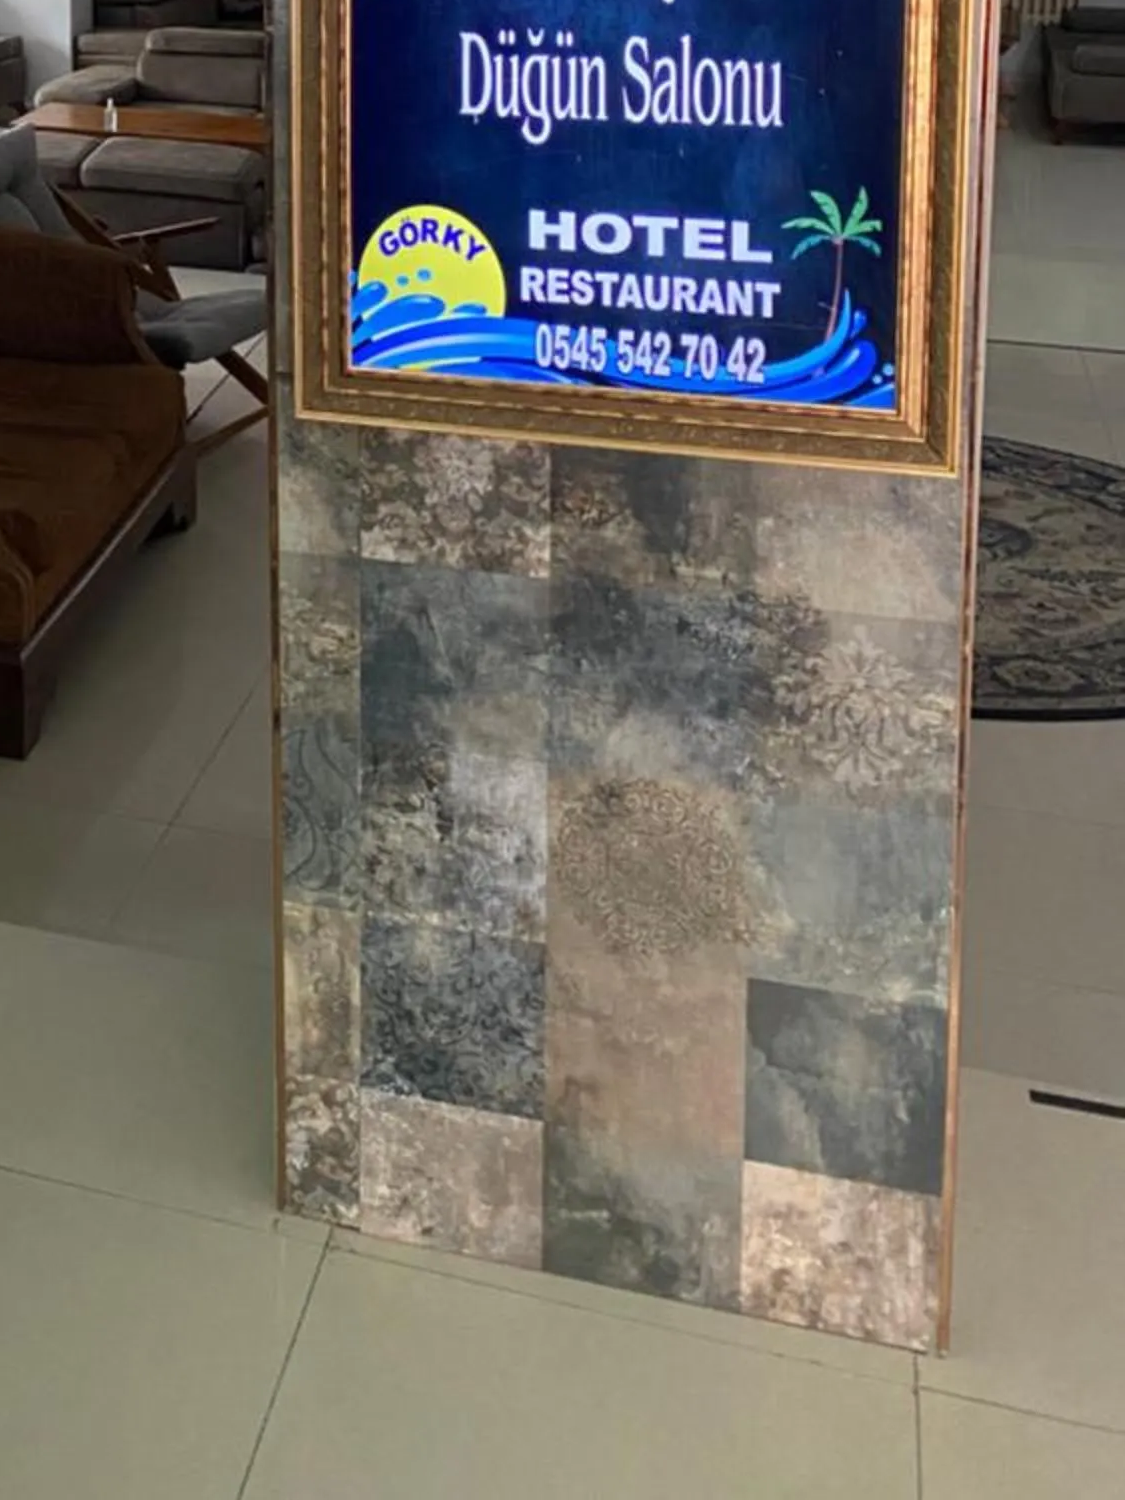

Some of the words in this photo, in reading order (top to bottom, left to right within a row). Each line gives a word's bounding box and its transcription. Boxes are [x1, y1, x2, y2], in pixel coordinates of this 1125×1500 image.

[459, 28, 608, 145] Düğün
[622, 35, 783, 127] Salonu
[377, 217, 486, 262] GÖRKY
[527, 209, 773, 263] HOTEL
[520, 266, 781, 319] RESTAURANT
[535, 324, 607, 373] 0545
[617, 329, 671, 376] 542
[680, 334, 718, 380] 70
[726, 336, 765, 384] 42
